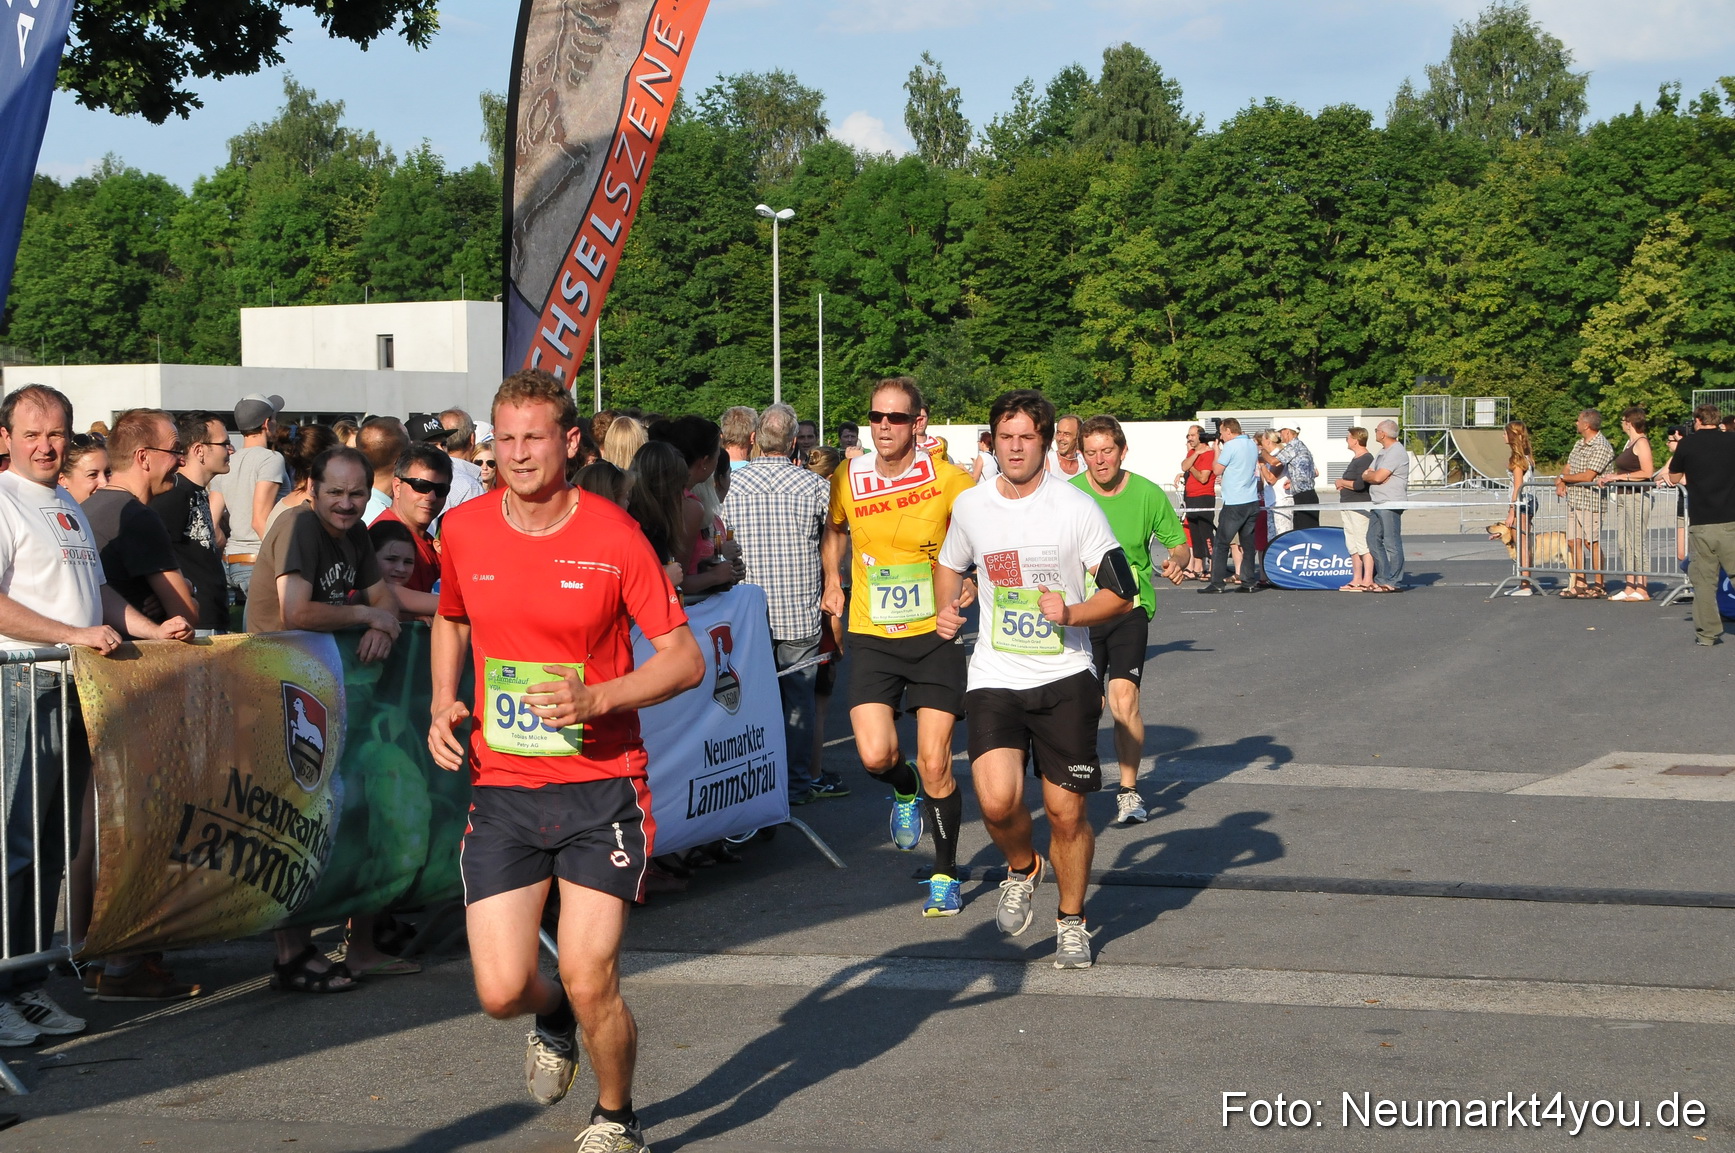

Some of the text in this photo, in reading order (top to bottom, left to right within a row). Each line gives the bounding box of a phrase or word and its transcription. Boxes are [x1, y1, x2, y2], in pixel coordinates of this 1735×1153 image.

[855, 486, 942, 518] MAX BÖGL
[986, 552, 1016, 564] GREAT
[988, 561, 1017, 572] PLACE
[1006, 569, 1018, 577] TO
[1031, 572, 1060, 583] 2012
[560, 580, 584, 589] Tobias
[877, 584, 920, 609] 791
[1002, 610, 1052, 638] 565
[496, 693, 562, 733] 95
[511, 732, 527, 740] Tobias
[704, 725, 765, 769] Neumarkter
[1068, 764, 1095, 773] DONNAY
[686, 755, 776, 820] Lammsbräu
